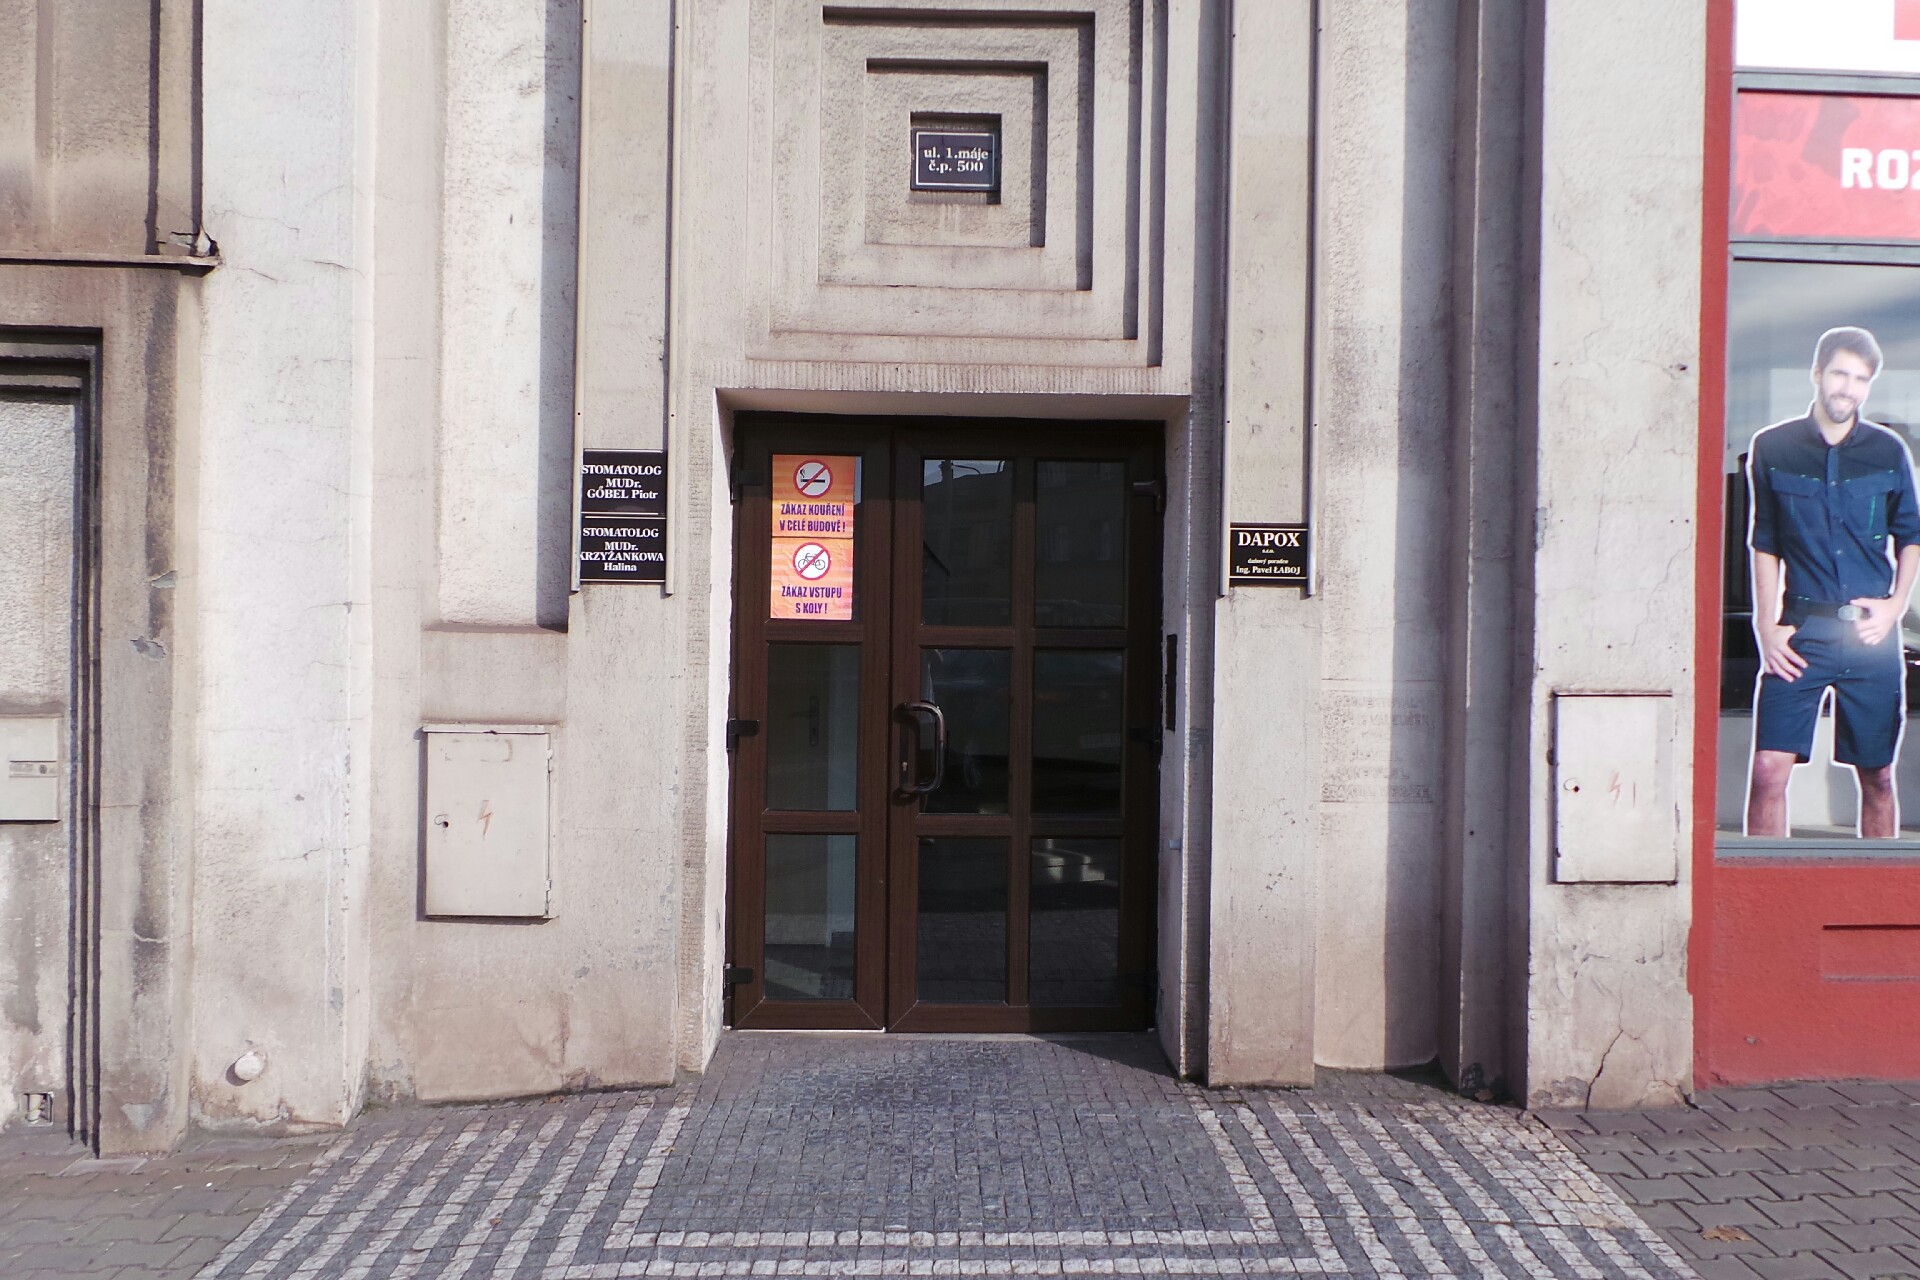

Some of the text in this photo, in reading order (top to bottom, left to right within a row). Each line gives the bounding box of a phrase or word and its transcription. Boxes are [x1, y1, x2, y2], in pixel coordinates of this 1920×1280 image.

[924, 147, 940, 158] ul.
[929, 160, 984, 173] č.p. 500
[581, 465, 662, 475] STOMATOLOG
[606, 478, 642, 488] MUDr.
[631, 490, 658, 499] Piotr
[781, 502, 845, 516] ZÁKAZ KOUŘENÍ
[780, 520, 786, 531] V
[787, 518, 806, 531] CELÉ
[583, 528, 659, 537] STOMATOLOG
[1238, 532, 1300, 546] DAPOX
[604, 541, 639, 551] MUDr.
[604, 562, 637, 571] Halina
[1236, 566, 1250, 575] Ing.
[1252, 566, 1272, 574] Pavel
[781, 584, 842, 598] ZÁKAZ VSTUPU
[795, 603, 801, 613] S
[802, 603, 822, 614] KOLY
